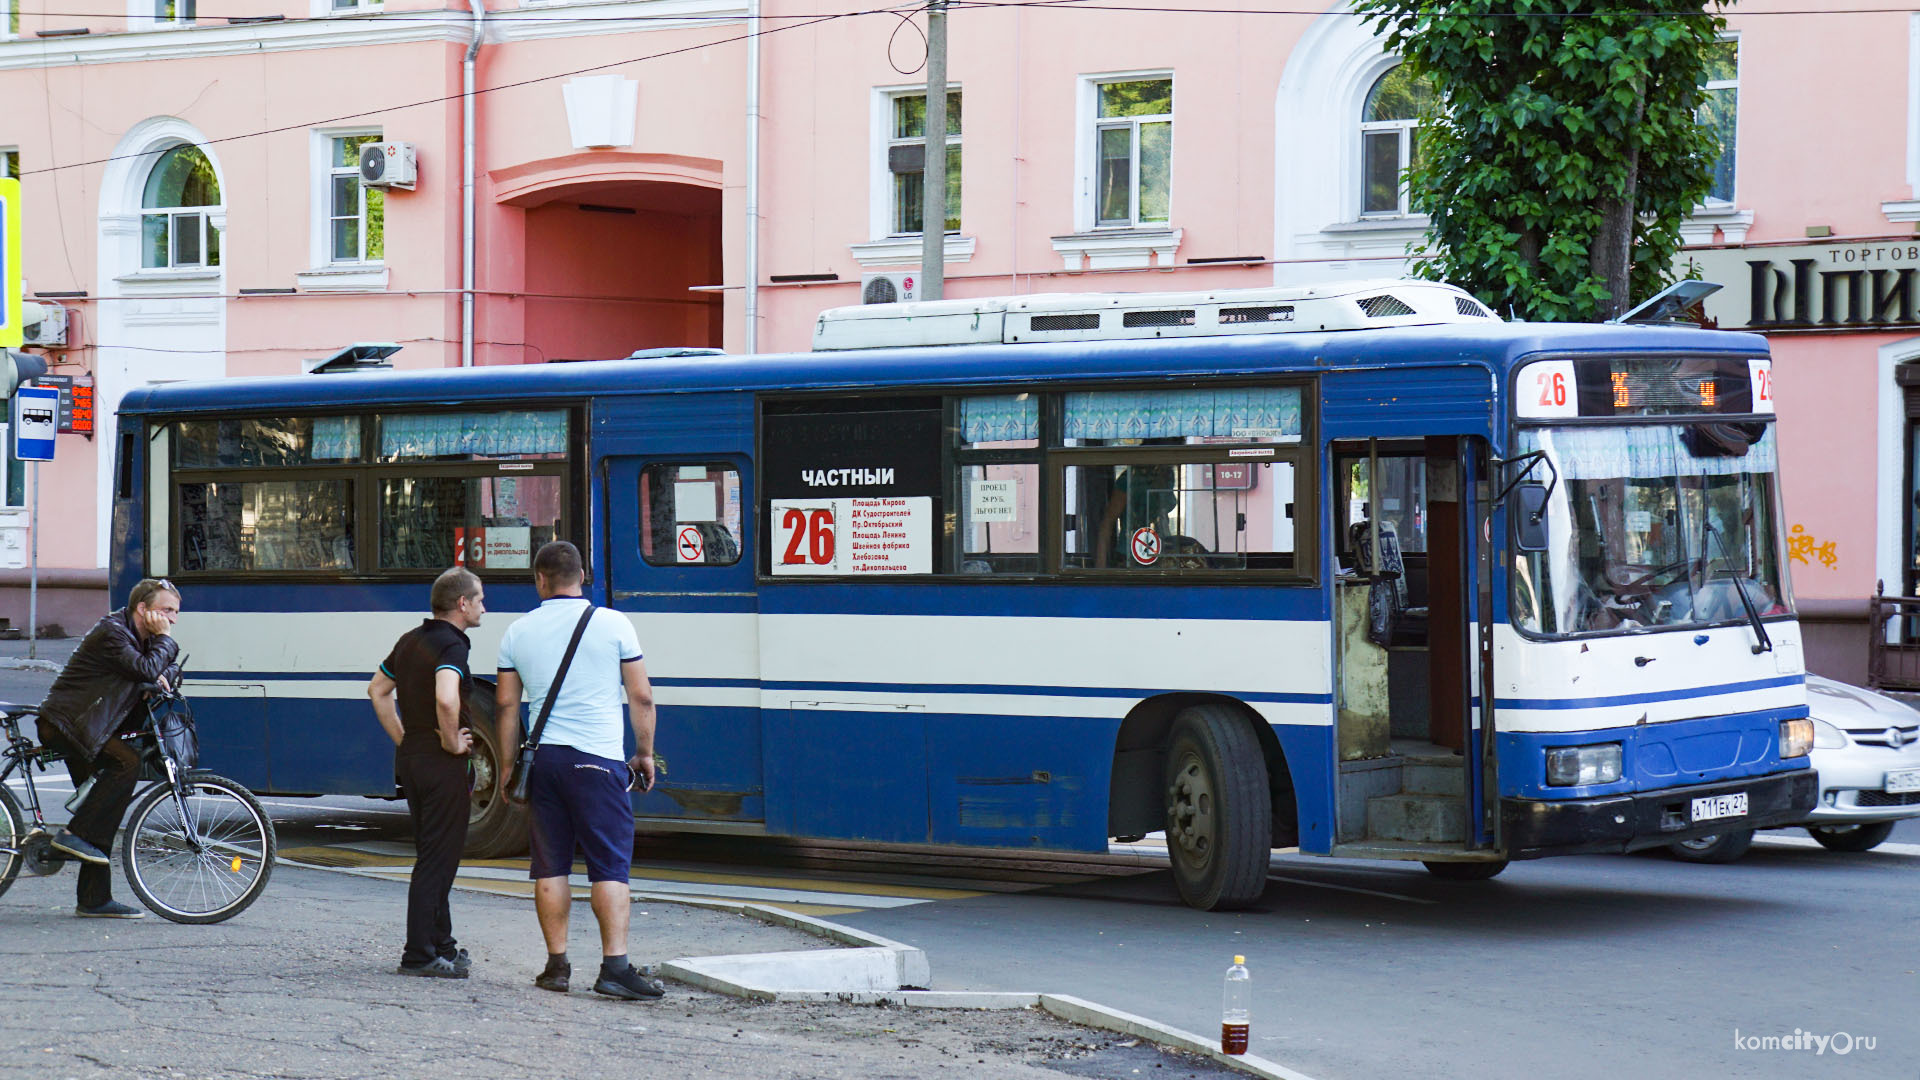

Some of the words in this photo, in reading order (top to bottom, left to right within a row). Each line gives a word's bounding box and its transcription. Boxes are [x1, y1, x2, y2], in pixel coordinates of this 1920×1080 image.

[903, 292, 913, 300] LG
[1537, 372, 1566, 406] 26
[1758, 369, 1773, 400] 26
[1221, 471, 1242, 479] 10-17
[852, 499, 880, 507] Площадь
[882, 498, 906, 507] Кирова
[852, 510, 862, 518] ДК
[863, 508, 911, 518] Судостроителей
[783, 508, 835, 565] 26
[852, 531, 880, 539] Площадь
[882, 531, 906, 539] Ленина
[458, 537, 483, 561] 26
[852, 542, 880, 550] Швейная
[882, 542, 910, 551] фабрика
[852, 552, 889, 561] Хлебозавод
[1695, 799, 1731, 818] А711ЕК
[1733, 794, 1744, 808] 27
